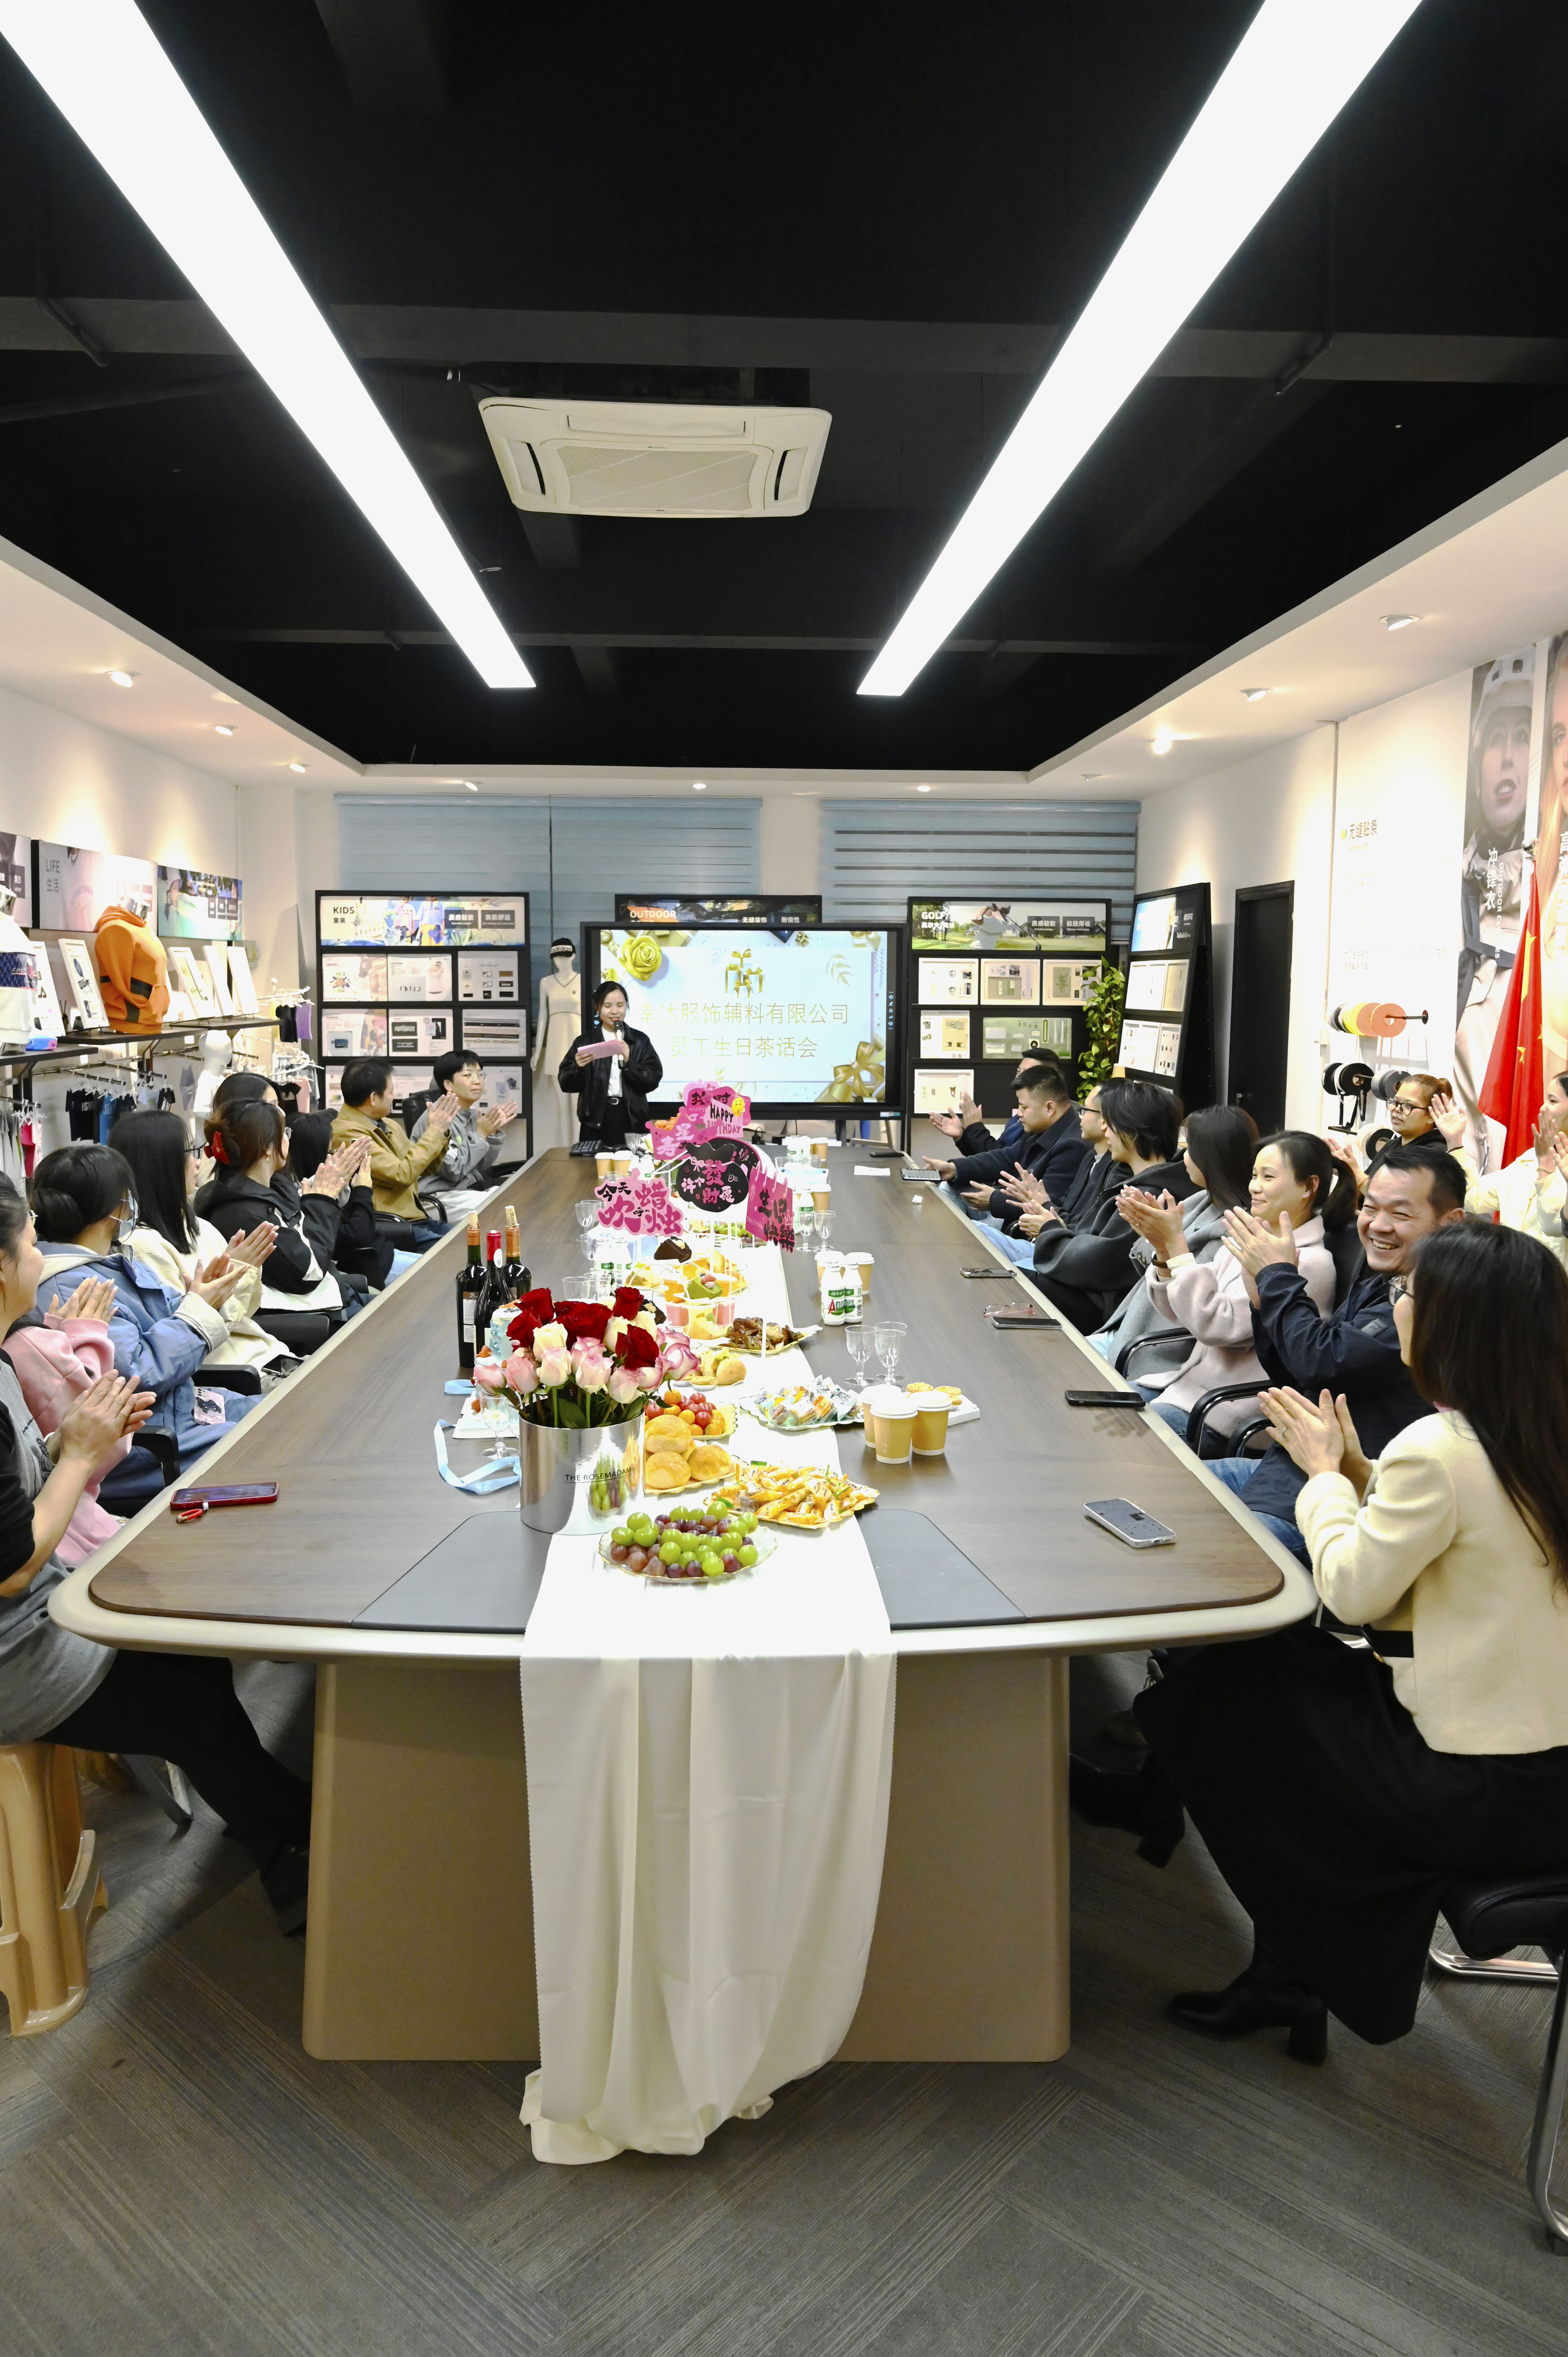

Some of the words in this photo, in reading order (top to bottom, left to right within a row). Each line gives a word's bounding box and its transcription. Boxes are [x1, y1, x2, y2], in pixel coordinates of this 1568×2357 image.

[1349, 820, 1377, 840] 无缝贴条
[46, 859, 60, 873] LIFE
[46, 877, 59, 892] 生活
[1485, 847, 1498, 910] 冲锋衣
[638, 1002, 849, 1025] 幸达服饰辅料有限公司
[671, 1036, 818, 1058] 员工生日茶话会
[710, 1104, 734, 1123] HAPPY
[657, 1123, 695, 1157] 寿星
[597, 1181, 632, 1202] 今天
[719, 1185, 735, 1203] 愿
[583, 1466, 631, 1481] ROSEMADAM
